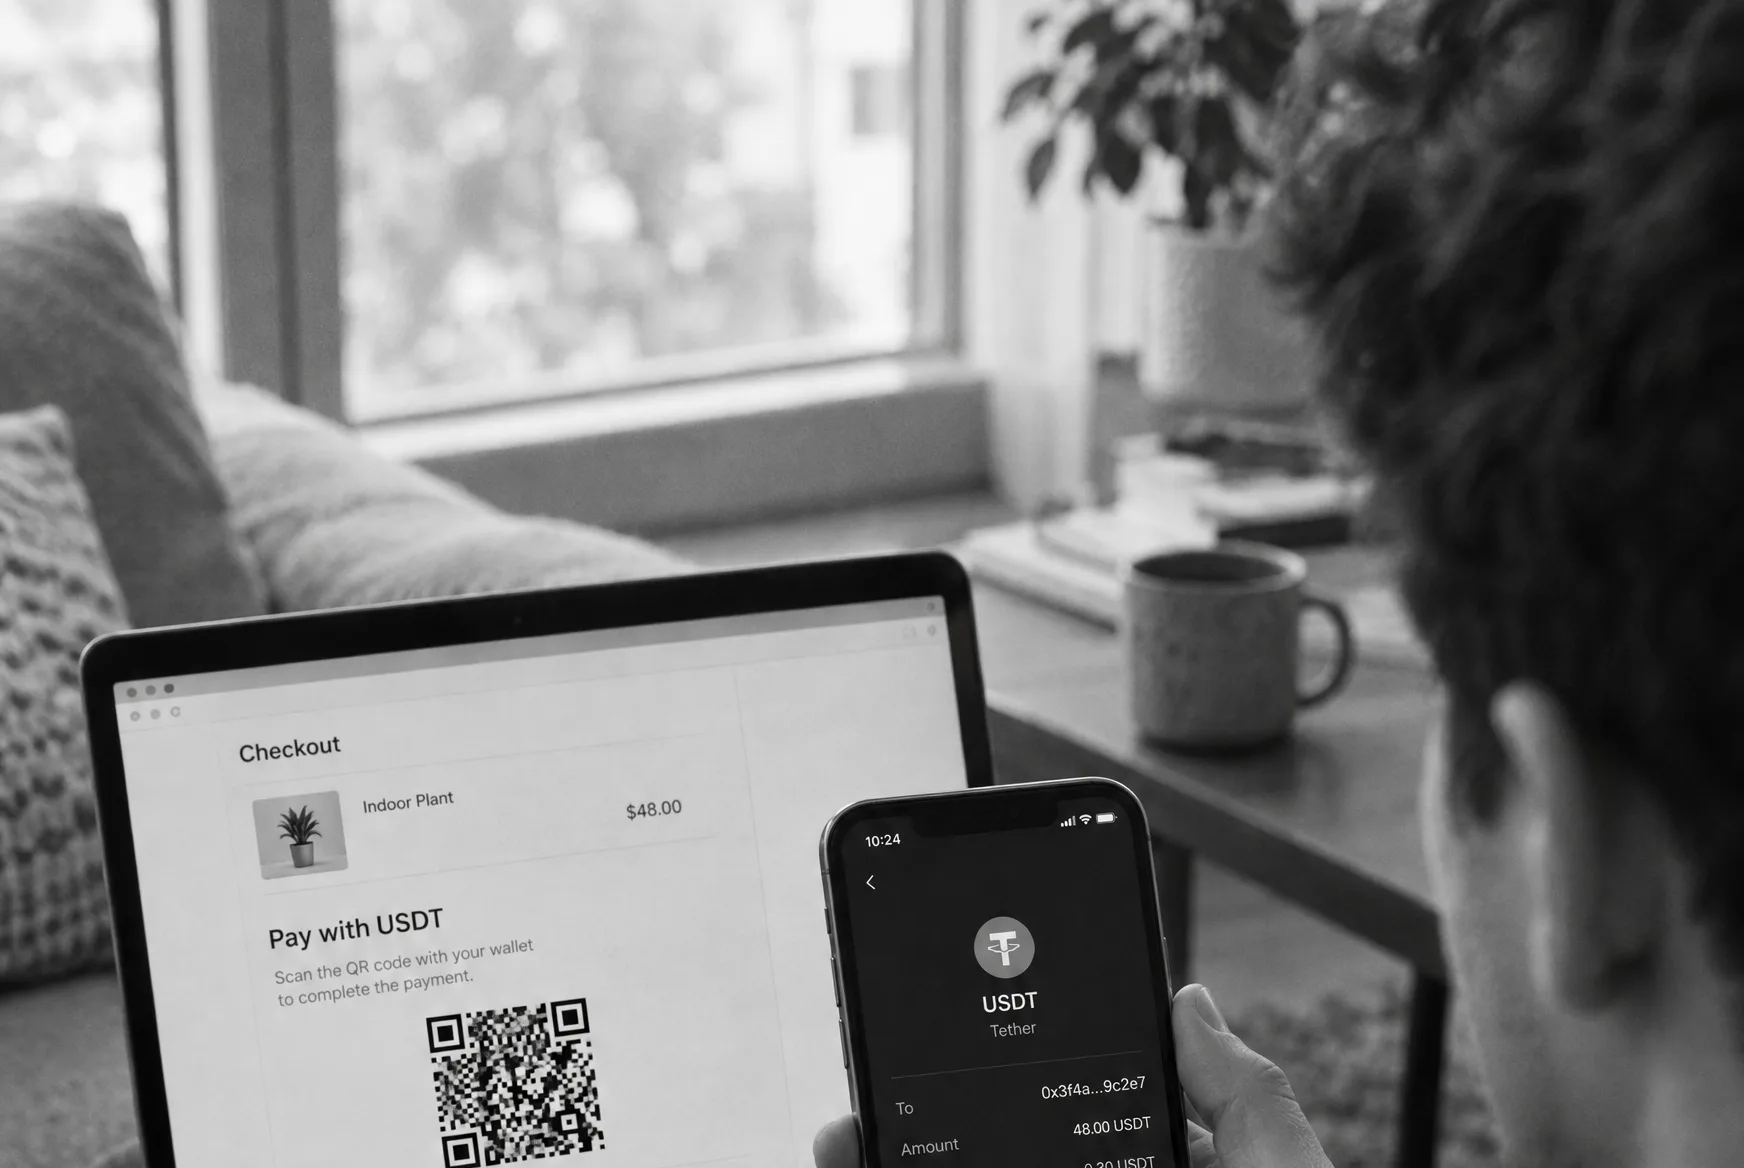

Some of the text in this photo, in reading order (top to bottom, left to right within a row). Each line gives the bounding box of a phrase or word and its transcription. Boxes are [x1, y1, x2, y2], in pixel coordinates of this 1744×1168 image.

[239, 736, 342, 763] Checkout
[362, 791, 455, 814] Indoor Plant
[626, 799, 682, 821] $48.00
[865, 833, 901, 848] 10:24
[268, 907, 444, 951] Pay with USDT
[274, 938, 535, 985] Scan the QR code with your wallet
[277, 969, 474, 1007] to complete the payment.
[982, 991, 1038, 1013] USDT
[989, 1022, 1037, 1038] Tether
[1041, 1075, 1146, 1100] 0x3f4a...9c2e7
[895, 1101, 914, 1115] To
[1073, 1115, 1151, 1136] 48.00 USDT
[901, 1138, 960, 1157] Amount
